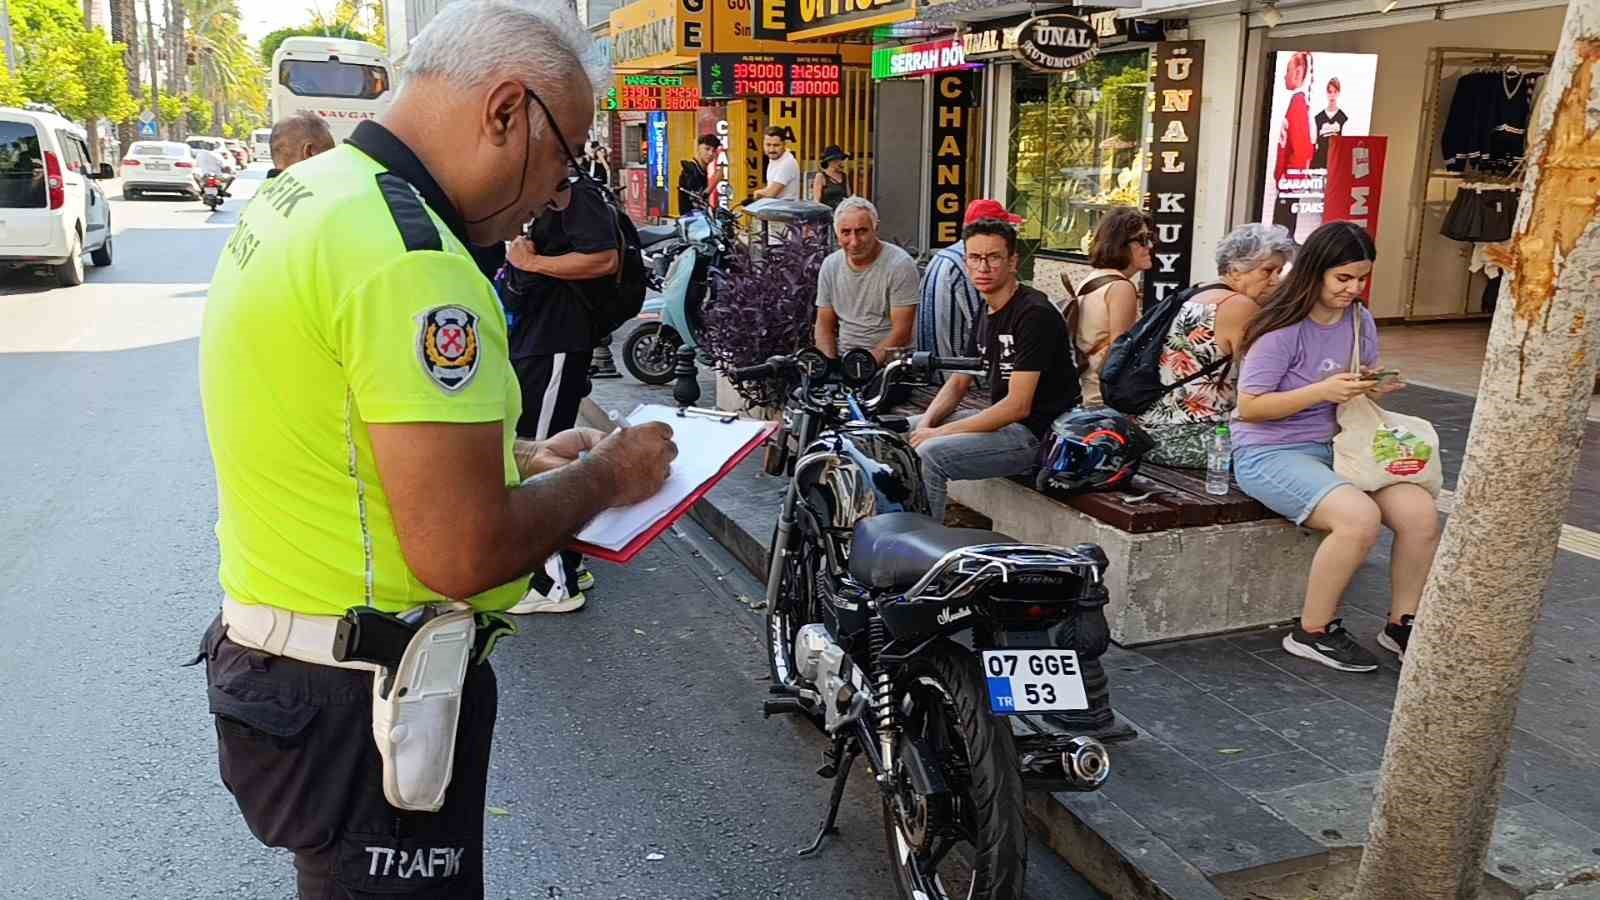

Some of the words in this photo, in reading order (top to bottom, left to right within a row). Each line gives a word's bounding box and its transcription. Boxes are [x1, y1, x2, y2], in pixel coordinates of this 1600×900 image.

[890, 49, 939, 74] SERRAH
[1023, 40, 1100, 68] KUYUMCULUK
[734, 64, 784, 78] 339000
[735, 80, 784, 94] 374000
[1160, 48, 1193, 173] ÜNAL
[747, 98, 759, 190] CHANG
[936, 77, 962, 242] CHANGE
[988, 655, 1018, 676] 07
[1028, 655, 1076, 676] GGE
[996, 696, 1014, 707] TR
[1024, 683, 1057, 705] 53
